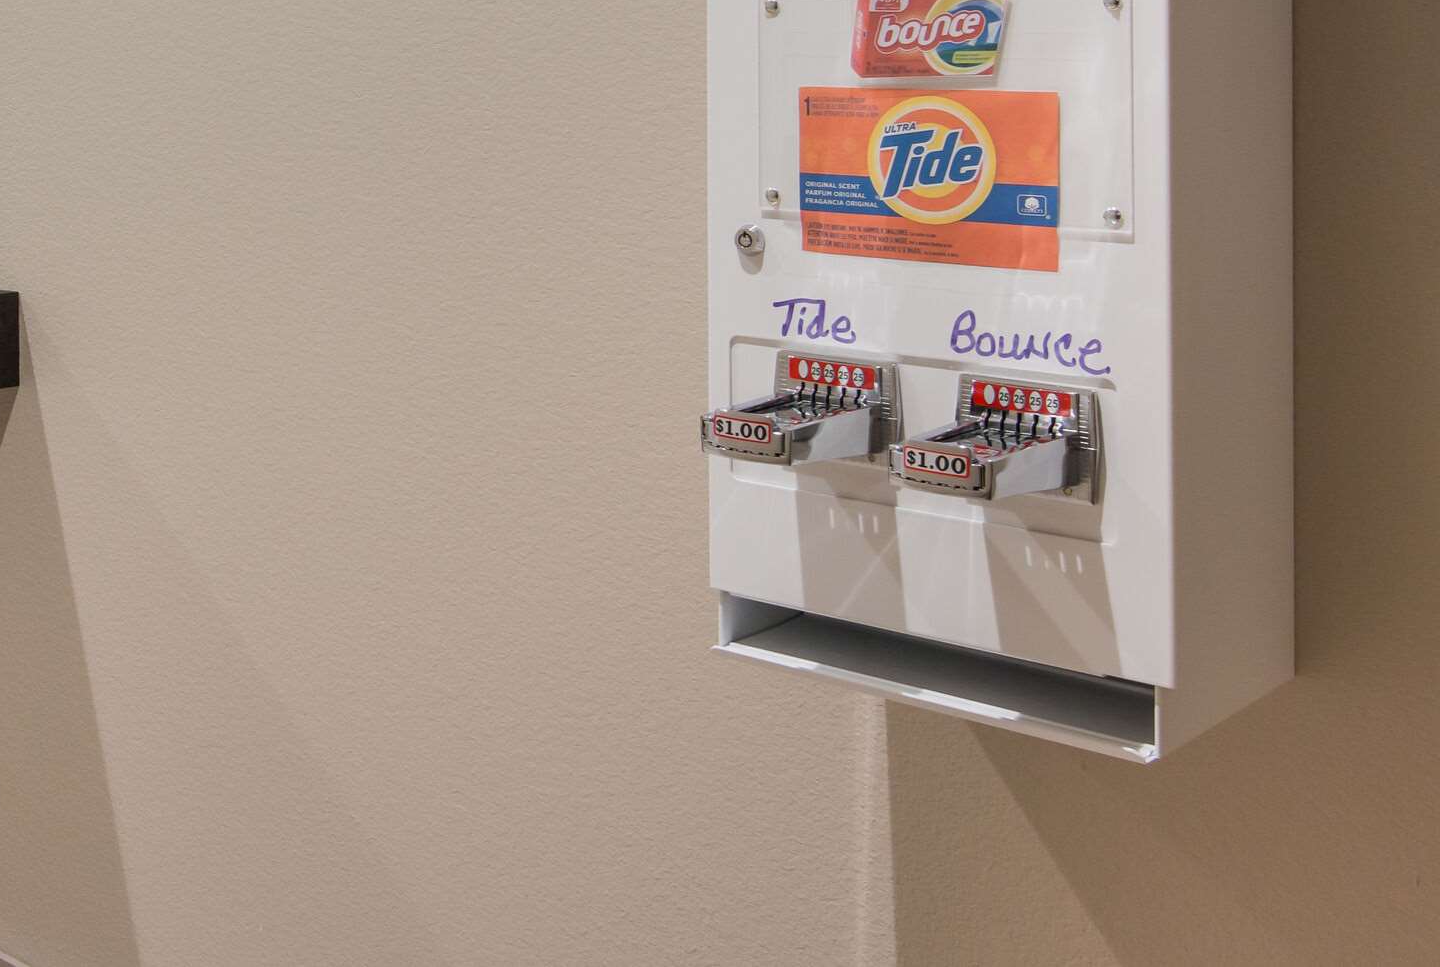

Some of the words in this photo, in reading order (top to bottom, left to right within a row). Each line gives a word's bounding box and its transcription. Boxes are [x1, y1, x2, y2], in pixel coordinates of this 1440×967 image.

[875, 10, 984, 52] bounce
[884, 122, 917, 135] ULTRA
[880, 129, 984, 200] Tide
[805, 180, 837, 189] ORIGINAL
[838, 182, 861, 190] SCENT
[805, 189, 832, 197] PARFUM
[833, 191, 866, 199] ORIGINAL
[805, 198, 845, 206] FRAGANCIA
[845, 200, 880, 208] ORIGINAL
[772, 297, 857, 344] Tide
[812, 366, 821, 375] 25
[825, 368, 834, 378] 25
[839, 370, 849, 380] 25
[853, 372, 864, 382] 25
[999, 392, 1009, 402] 25
[1014, 394, 1025, 404] 25
[1030, 396, 1041, 406] 25
[1047, 398, 1058, 408] 25
[715, 418, 767, 441] $1.00
[906, 451, 966, 475] $1.00
